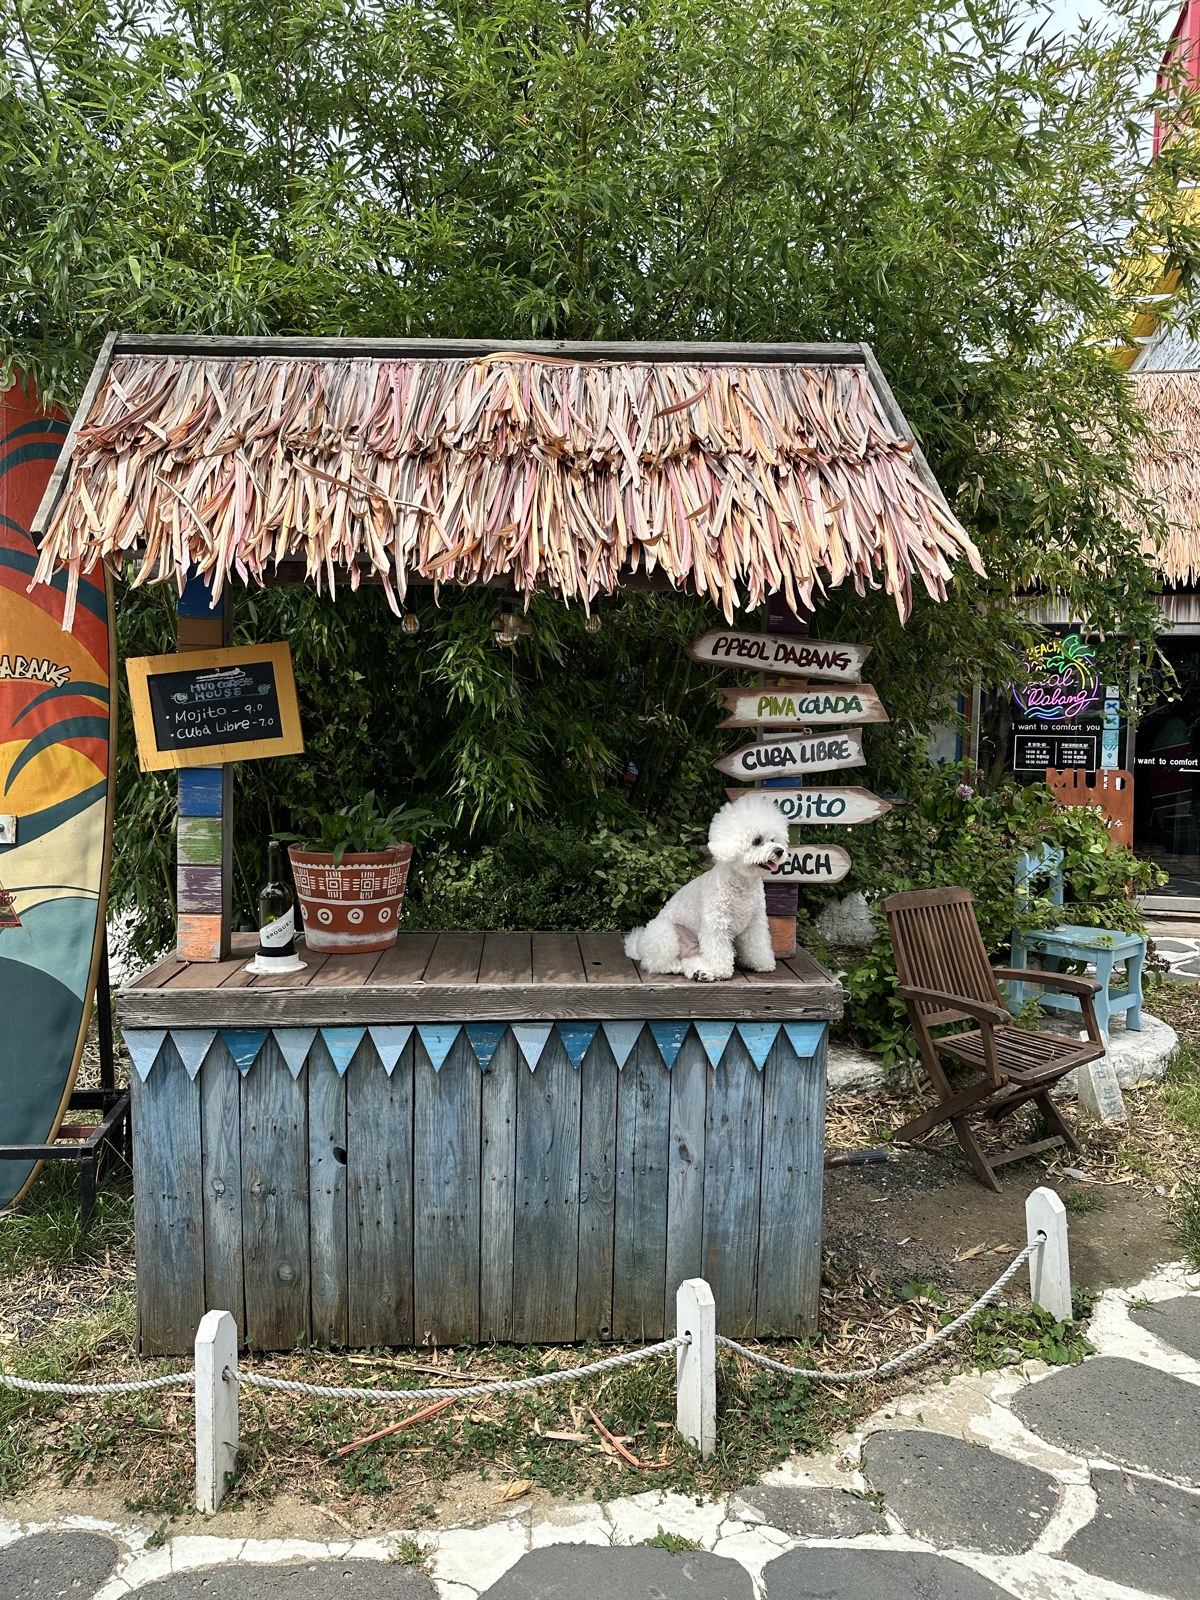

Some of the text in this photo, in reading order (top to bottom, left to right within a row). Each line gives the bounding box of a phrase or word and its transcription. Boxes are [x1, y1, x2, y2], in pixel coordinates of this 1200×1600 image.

[711, 636, 852, 671] PPEOL DABANG
[0, 654, 72, 689] ABANG
[194, 687, 242, 701] HOUSE
[175, 706, 227, 724] Mojito
[244, 703, 263, 716] 9.0
[215, 718, 250, 734] Libre
[1018, 723, 1037, 731] want
[1040, 723, 1048, 731] to
[1051, 723, 1082, 731] comfort
[1086, 724, 1101, 732] you
[741, 739, 852, 771] CUBA LIBRE
[1138, 757, 1156, 765] want
[1159, 757, 1167, 765] to
[1169, 758, 1199, 766] comfort
[1046, 767, 1134, 790] MUD
[773, 793, 846, 819] ojito
[266, 920, 292, 939] BROQUEL
